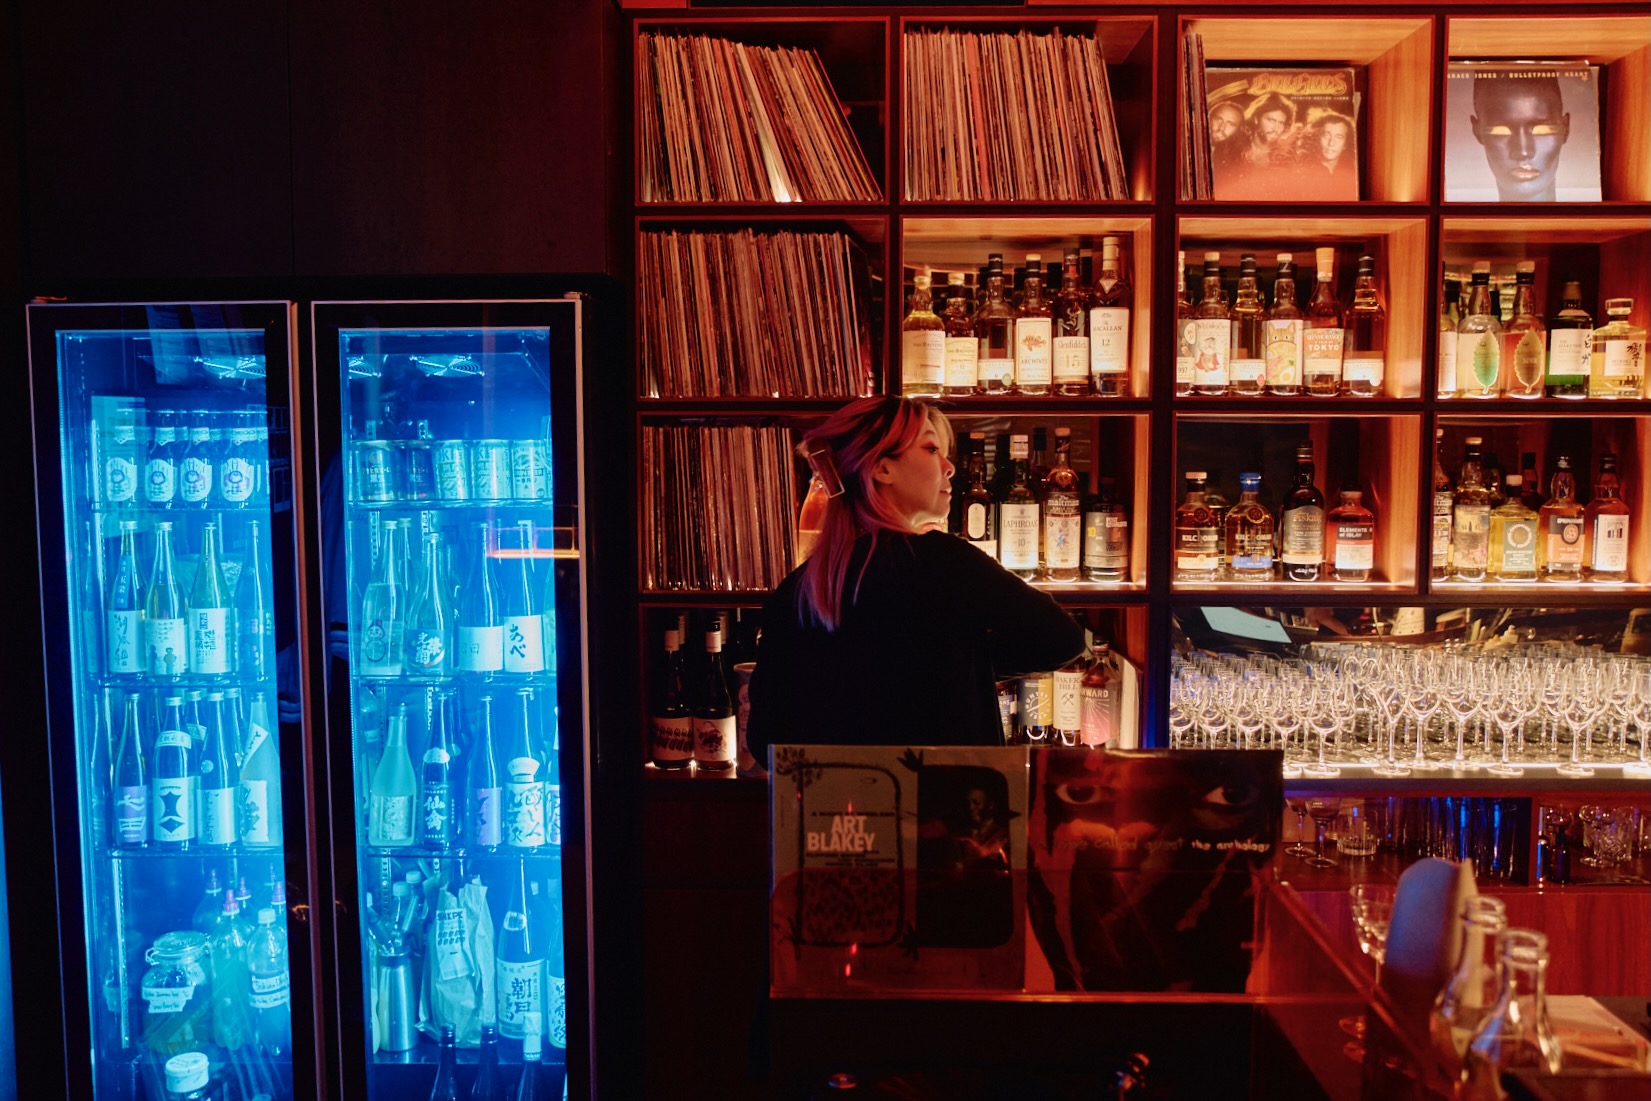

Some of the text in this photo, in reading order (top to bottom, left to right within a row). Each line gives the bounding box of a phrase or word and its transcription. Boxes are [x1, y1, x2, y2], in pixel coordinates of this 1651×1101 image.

[1101, 338, 1111, 347] 12
[509, 623, 528, 659] あべ
[1055, 676, 1083, 684] BAKER
[1080, 689, 1109, 698] RWARD
[831, 815, 868, 834] ART
[807, 832, 876, 853] BLAKEY
[1094, 837, 1138, 850] called
[1144, 837, 1185, 858] quest
[1191, 839, 1211, 852] the
[1215, 839, 1272, 854] anthology
